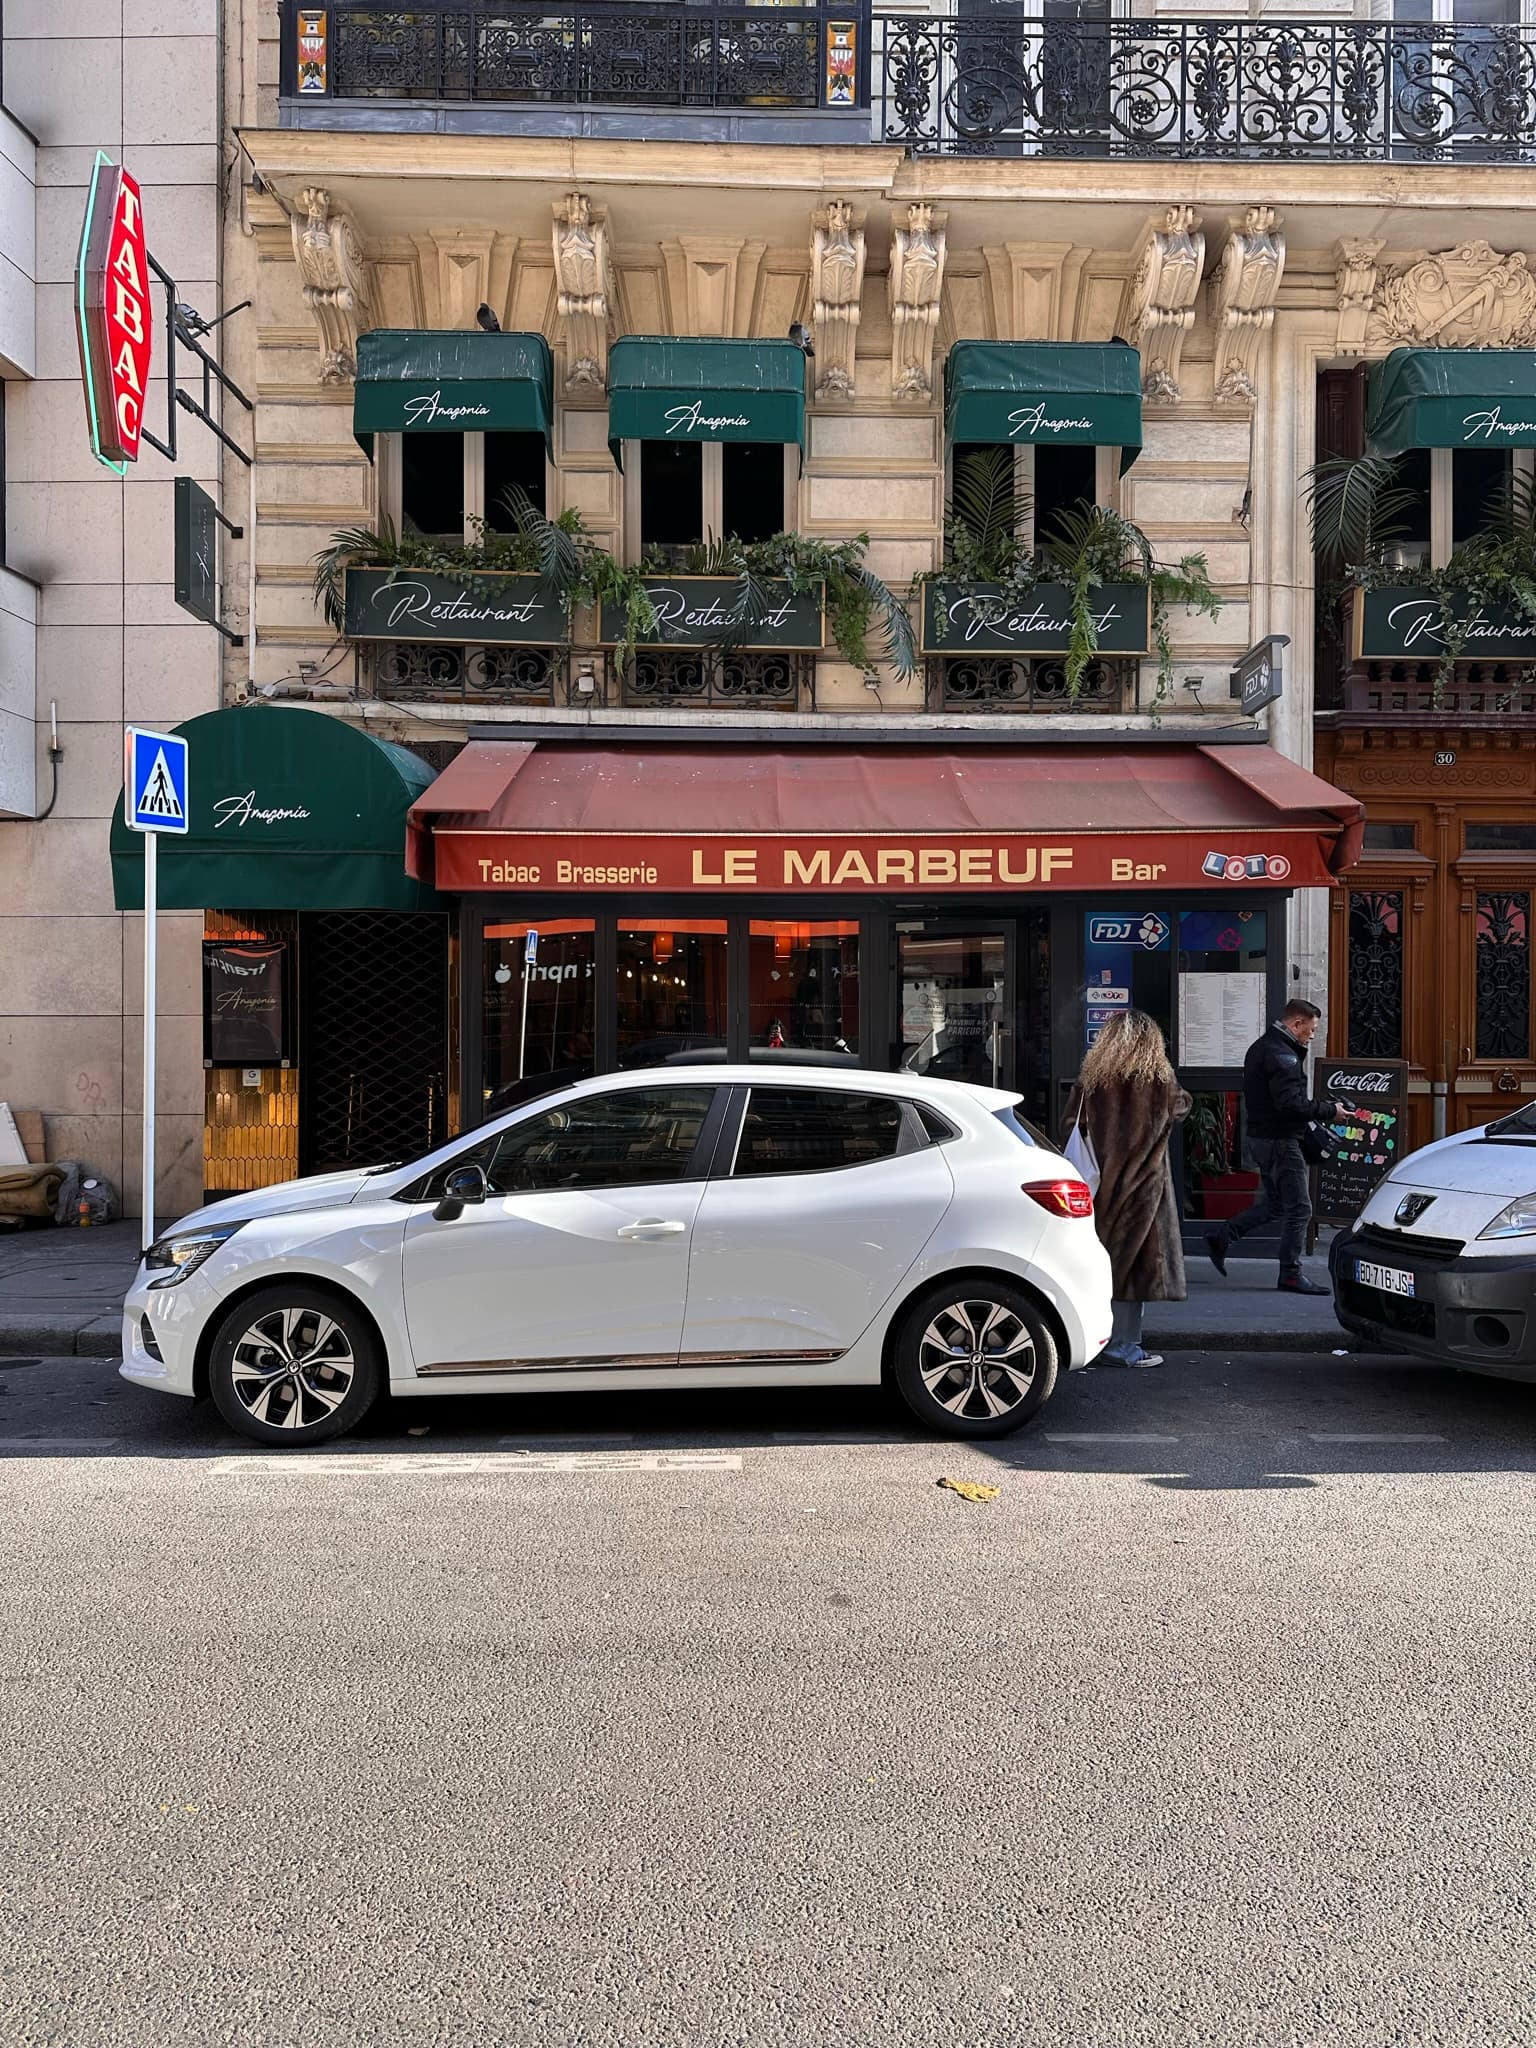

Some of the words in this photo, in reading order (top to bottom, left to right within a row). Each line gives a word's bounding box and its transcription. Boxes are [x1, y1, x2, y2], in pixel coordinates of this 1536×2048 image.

[113, 182, 144, 441] TABAC
[1462, 405, 1536, 441] Amazon
[371, 581, 545, 628] Restaurant
[643, 588, 797, 635] Restant
[948, 594, 1122, 641] Restaurt
[1387, 599, 1536, 647] Retauran
[1245, 673, 1258, 697] FDJ
[1437, 753, 1453, 764] 30
[478, 858, 541, 884] Tabac
[557, 860, 658, 885] Brasserie
[692, 850, 757, 885] LE
[783, 847, 1074, 885] MARBEUF
[1111, 857, 1167, 882] Bar
[1202, 851, 1290, 881] LOTO
[1095, 923, 1132, 939] FDJ
